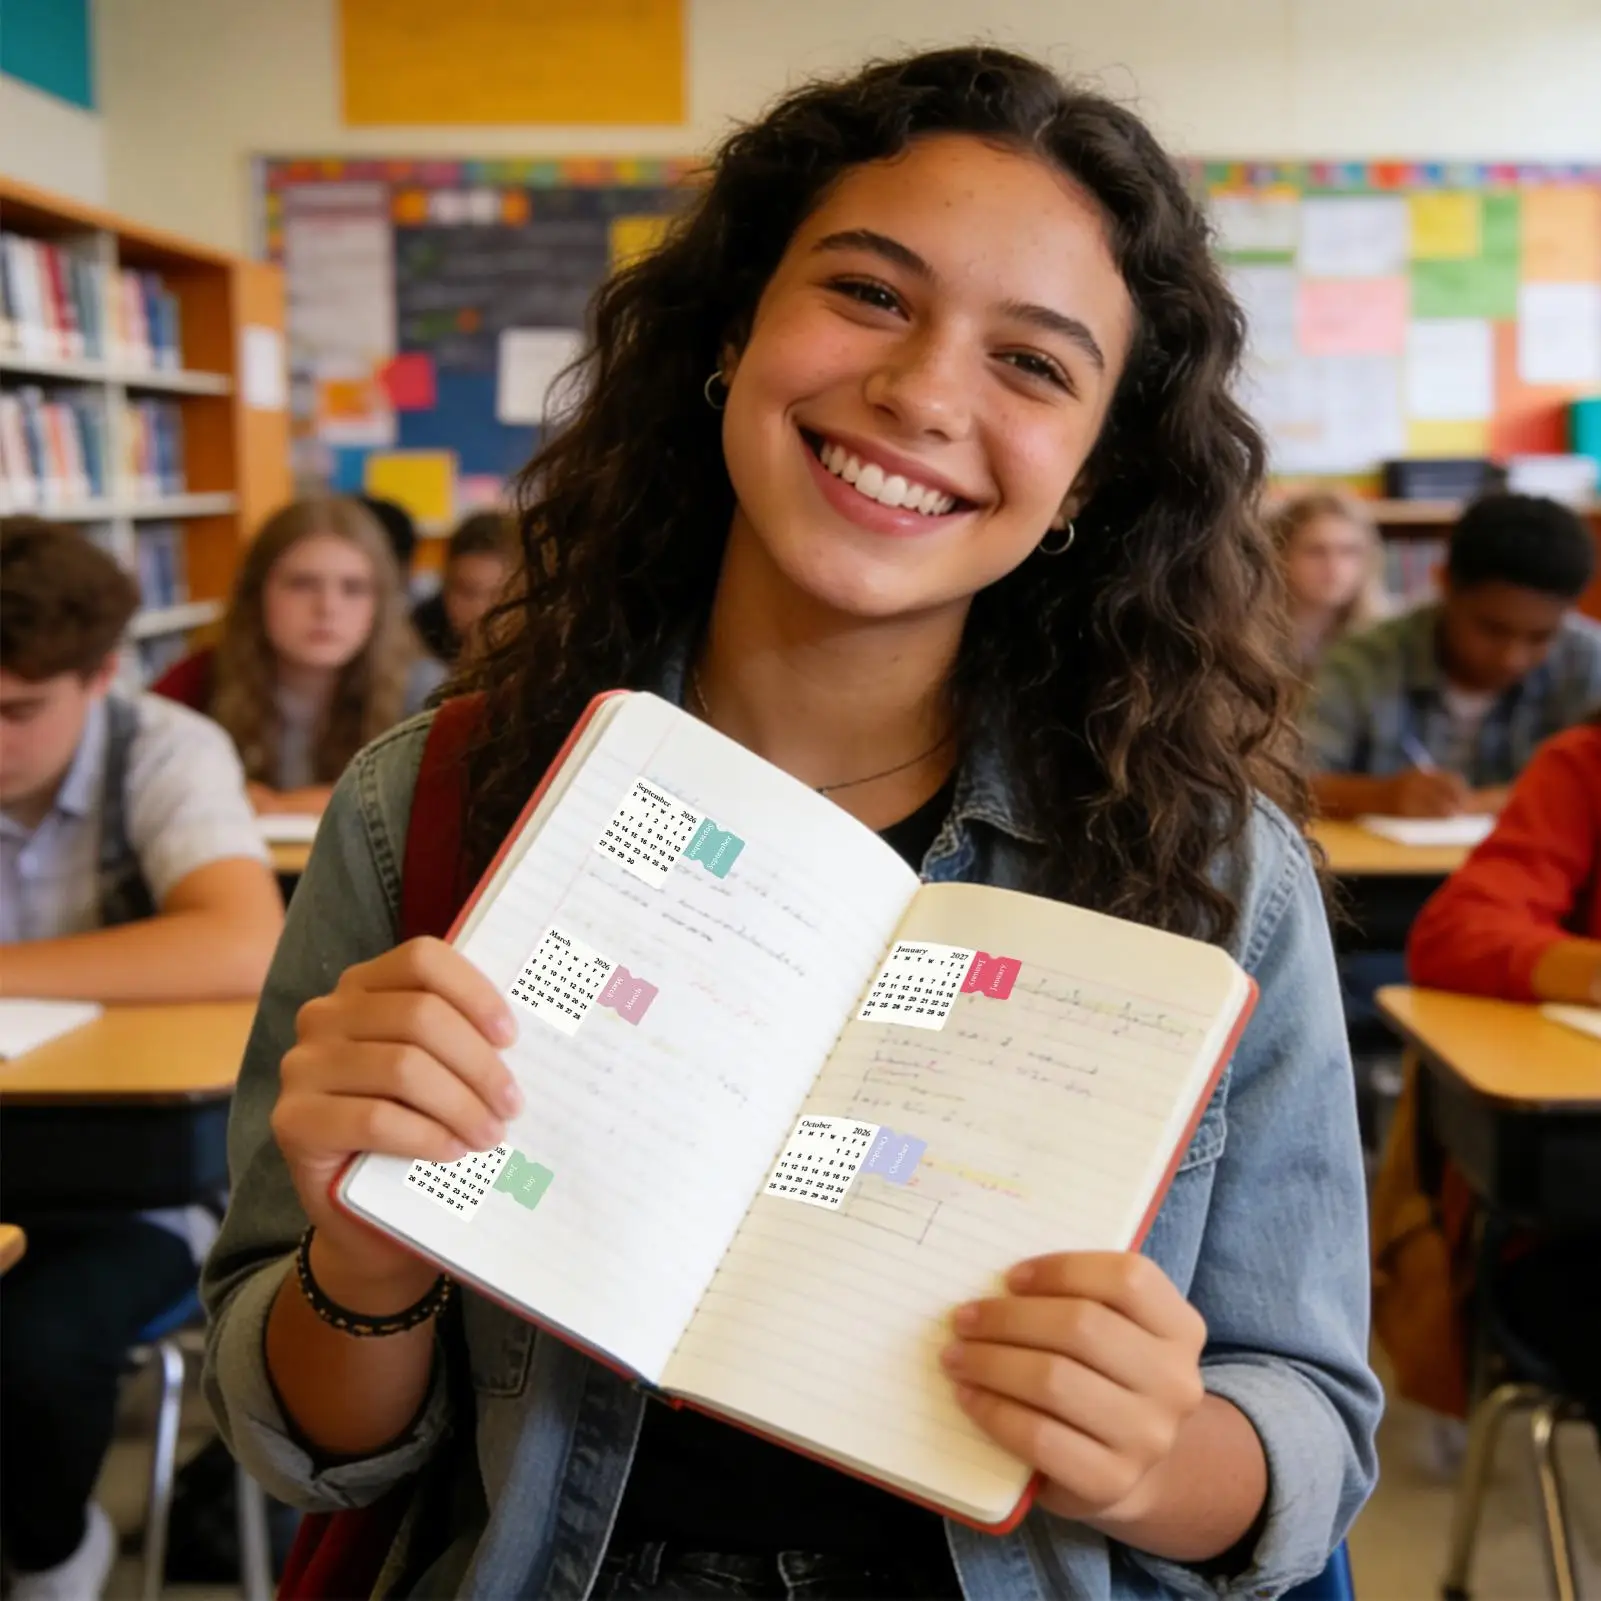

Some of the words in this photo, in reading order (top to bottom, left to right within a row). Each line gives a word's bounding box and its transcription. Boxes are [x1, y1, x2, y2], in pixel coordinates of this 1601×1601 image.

[636, 782, 671, 807] September
[681, 811, 697, 823] 2026
[549, 930, 572, 947] March
[594, 958, 610, 970] 2026
[896, 946, 928, 954] January
[950, 952, 969, 960] 2027
[969, 959, 986, 986] January
[990, 964, 1008, 991] January
[608, 977, 624, 998] March
[802, 1120, 832, 1129] October
[852, 1128, 871, 1136] 2026
[494, 1147, 506, 1156] 26
[505, 1164, 518, 1180] July
